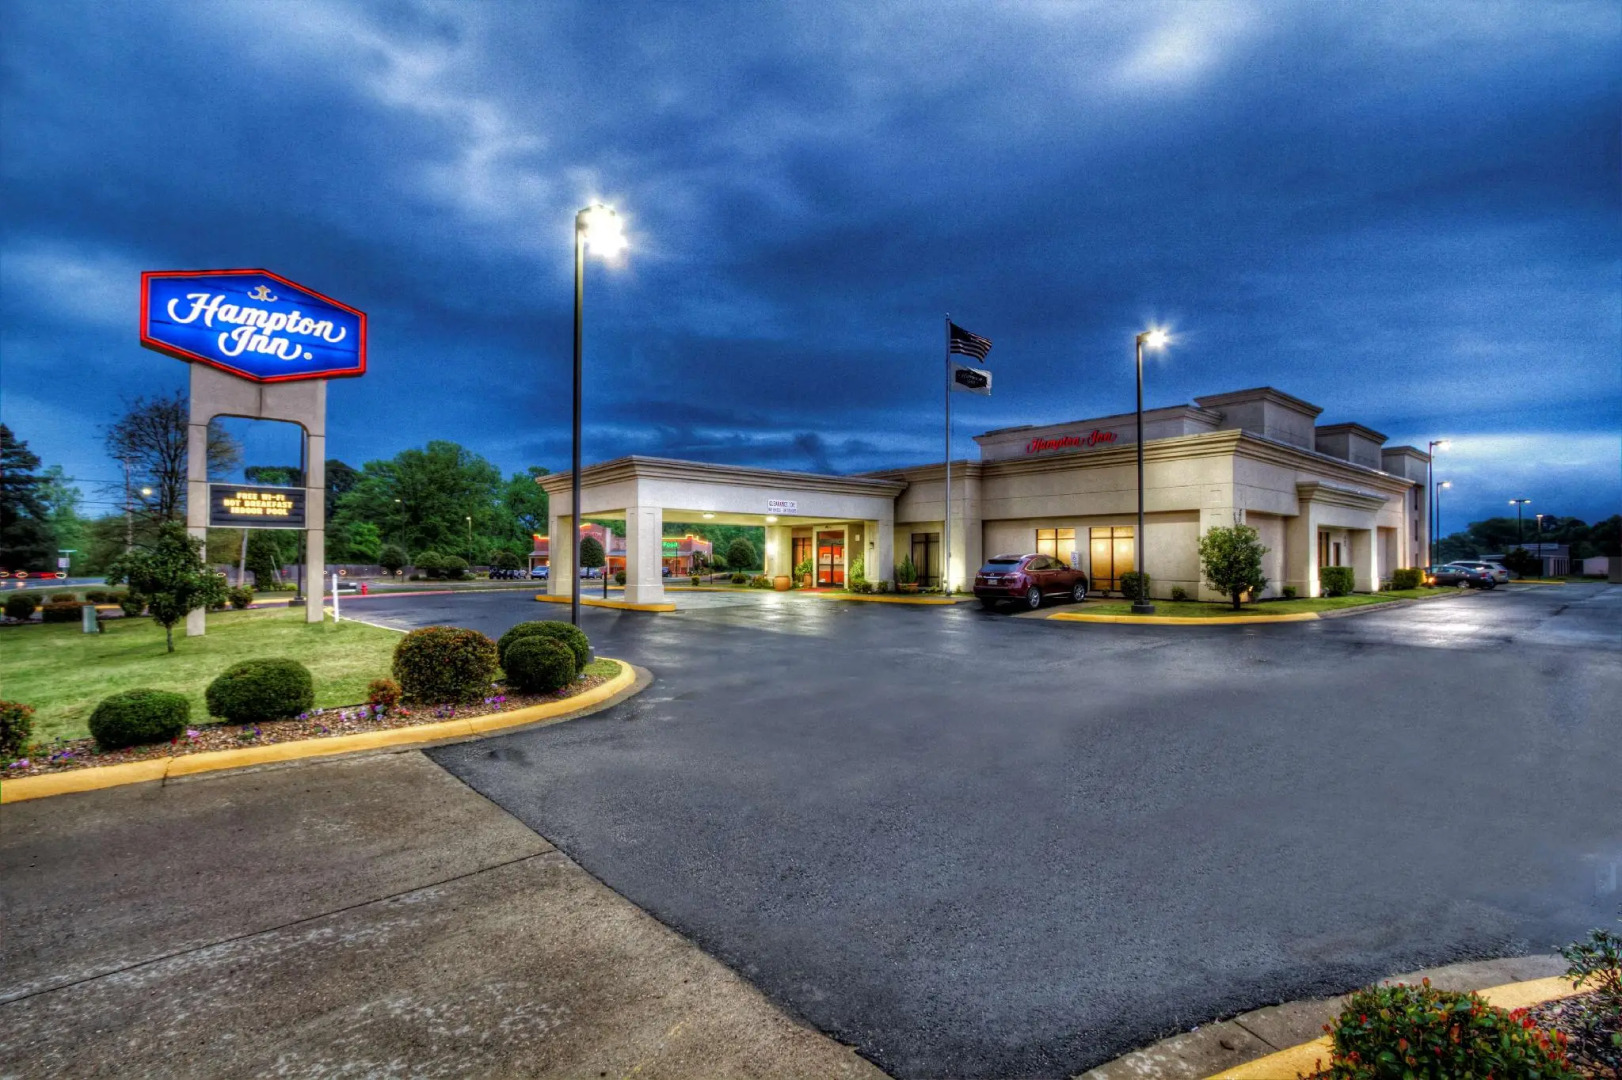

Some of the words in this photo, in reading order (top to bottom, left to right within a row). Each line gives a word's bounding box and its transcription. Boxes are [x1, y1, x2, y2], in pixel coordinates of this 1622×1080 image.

[167, 293, 346, 343] Hampton
[1026, 435, 1085, 454] Hampton
[1087, 430, 1117, 447] Inn
[223, 498, 241, 507] HOT
[244, 500, 293, 509] BREAKFAST
[236, 492, 258, 500] FREE
